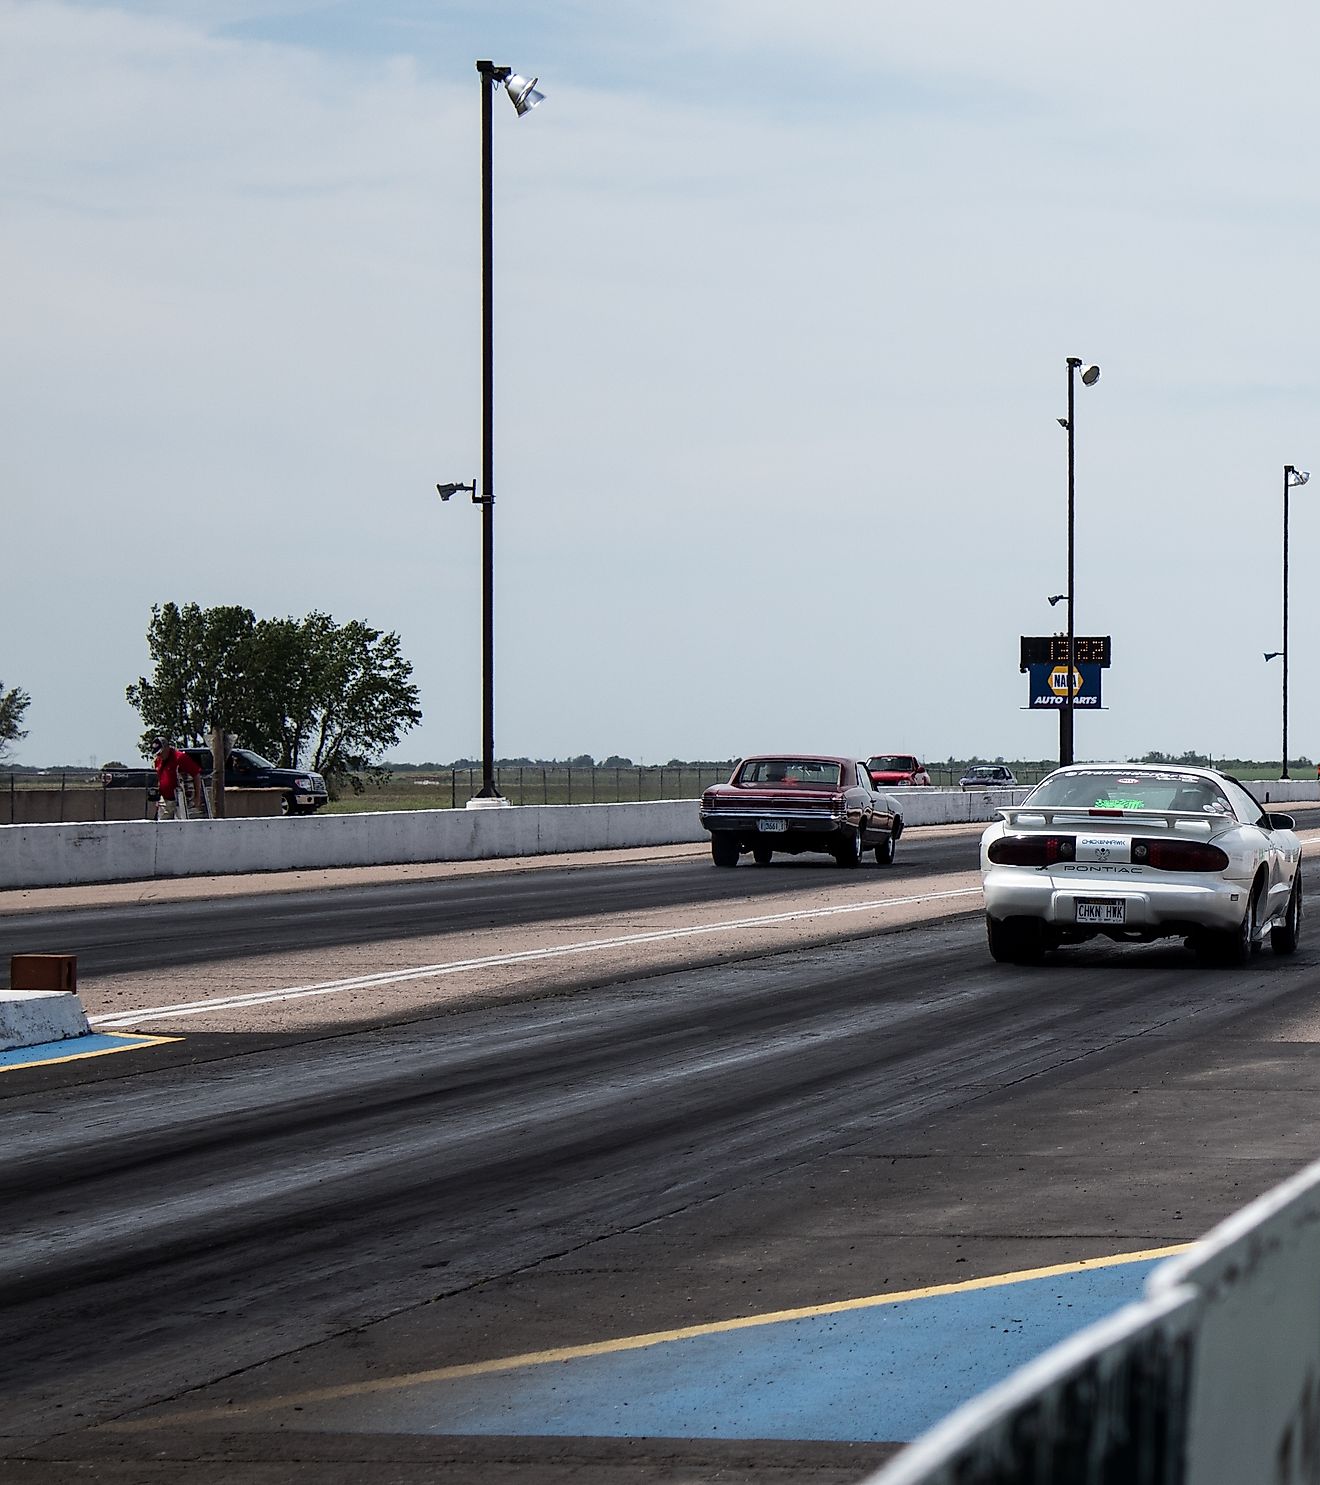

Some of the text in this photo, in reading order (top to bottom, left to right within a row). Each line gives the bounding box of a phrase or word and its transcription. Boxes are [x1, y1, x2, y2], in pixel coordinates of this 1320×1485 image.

[1034, 696, 1063, 705] AUTO
[1064, 865, 1143, 874] PONTIAC
[1078, 905, 1123, 919] CHKN HWK
